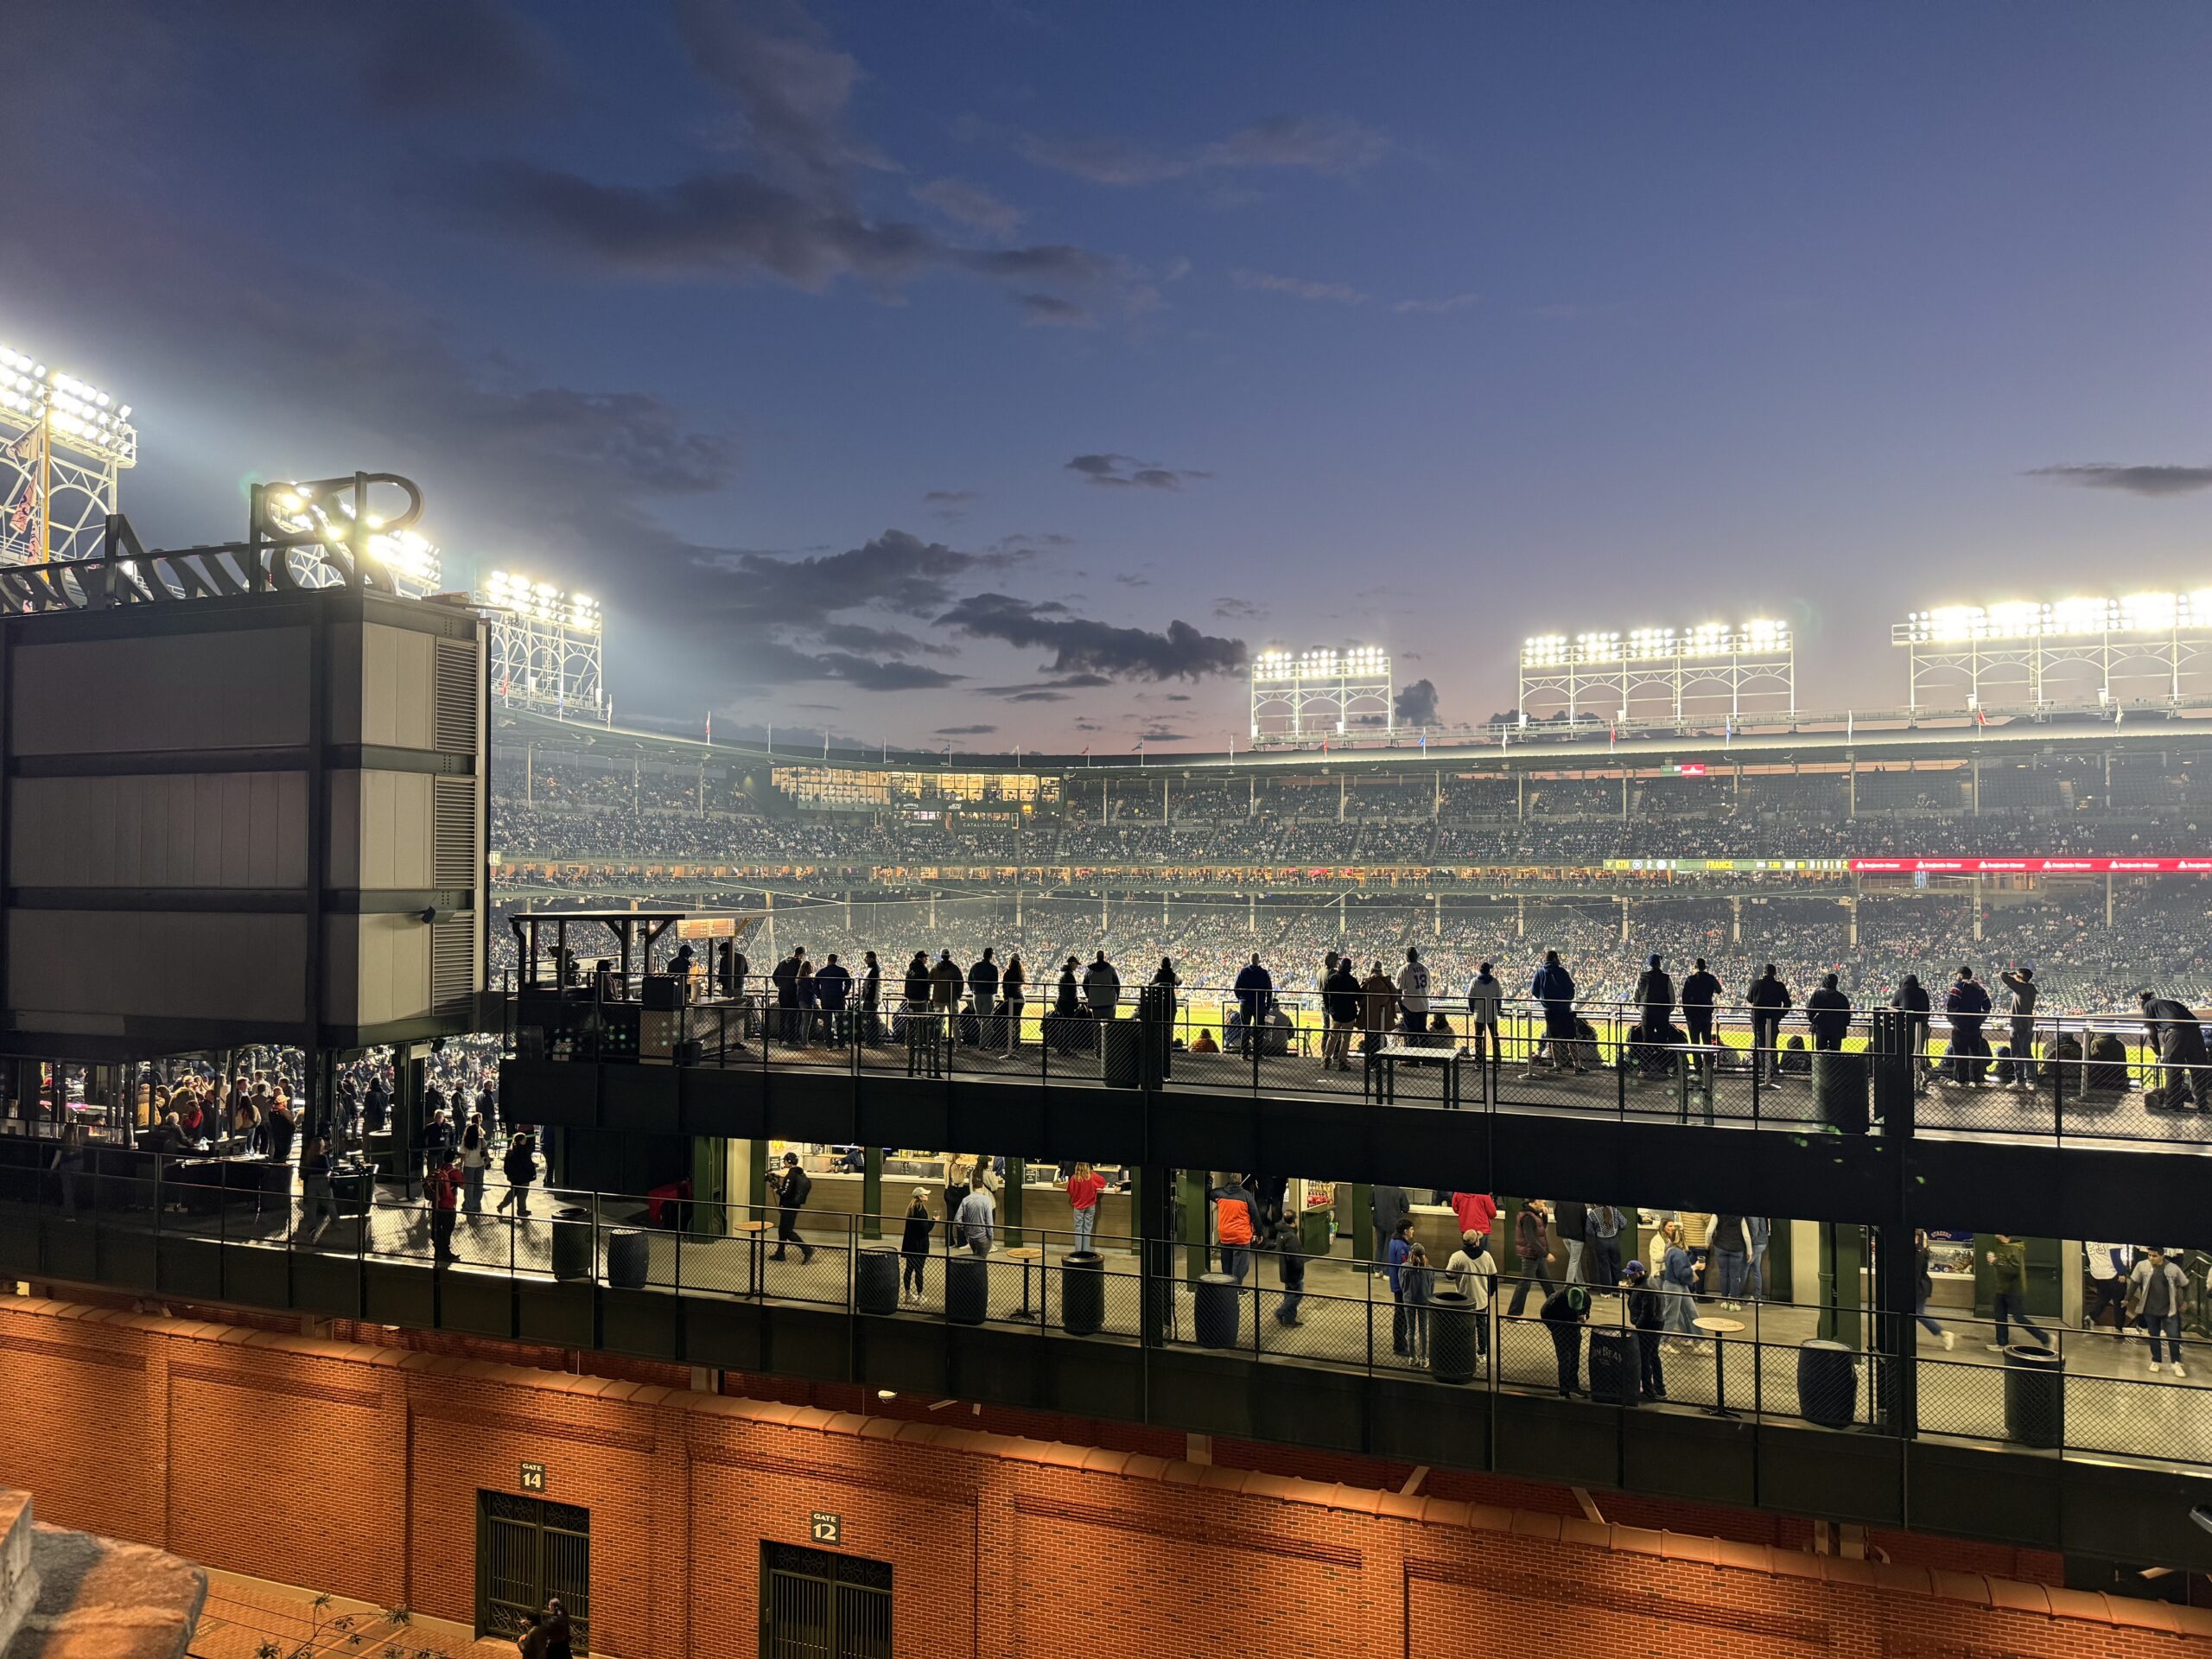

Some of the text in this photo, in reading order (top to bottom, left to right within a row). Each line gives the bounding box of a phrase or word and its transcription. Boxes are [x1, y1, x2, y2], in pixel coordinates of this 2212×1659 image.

[1706, 861, 1734, 869] FRANCE
[522, 1463, 543, 1471] GATE
[522, 1471, 542, 1489] 14
[813, 1513, 837, 1523] GATE
[813, 1523, 836, 1541] 12
